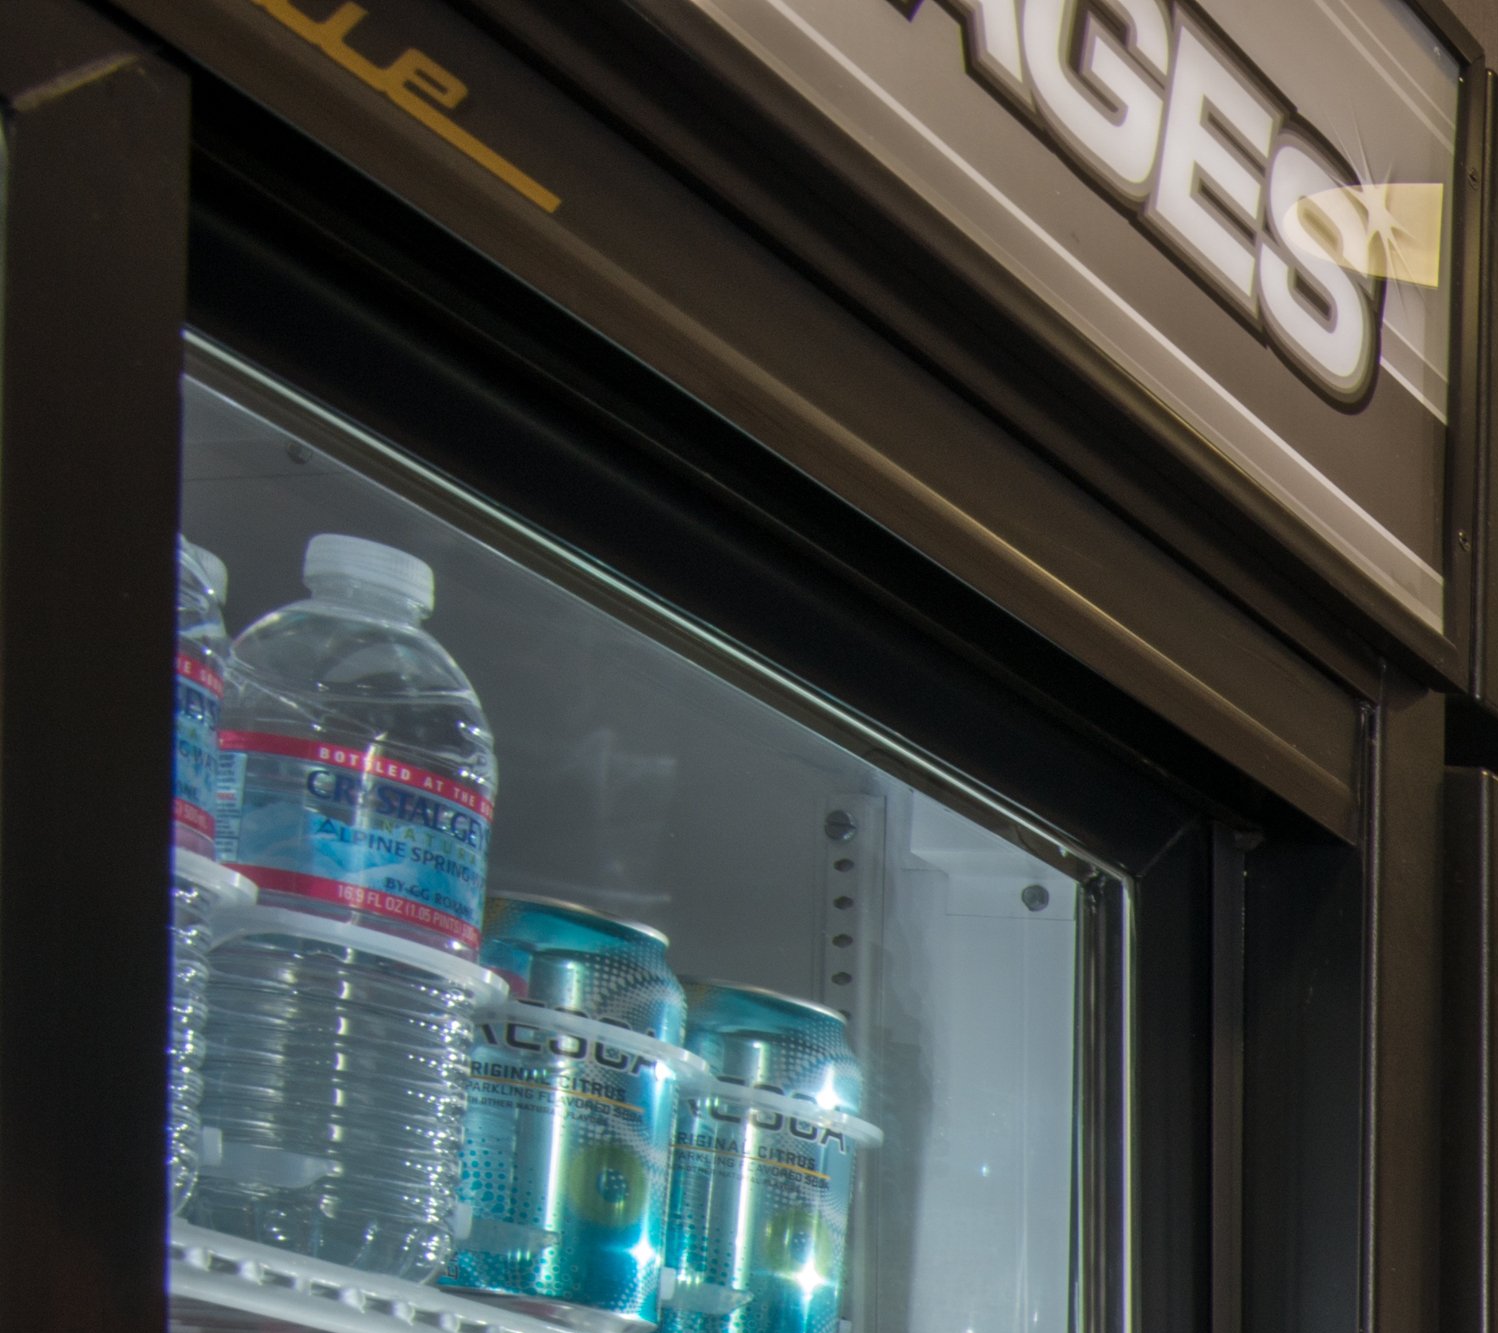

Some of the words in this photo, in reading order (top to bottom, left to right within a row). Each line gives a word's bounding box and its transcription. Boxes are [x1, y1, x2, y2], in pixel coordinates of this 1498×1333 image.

[423, 775, 445, 792] AT
[452, 786, 476, 809] THE
[315, 817, 407, 861] ALPINE
[410, 847, 472, 884] SPRING
